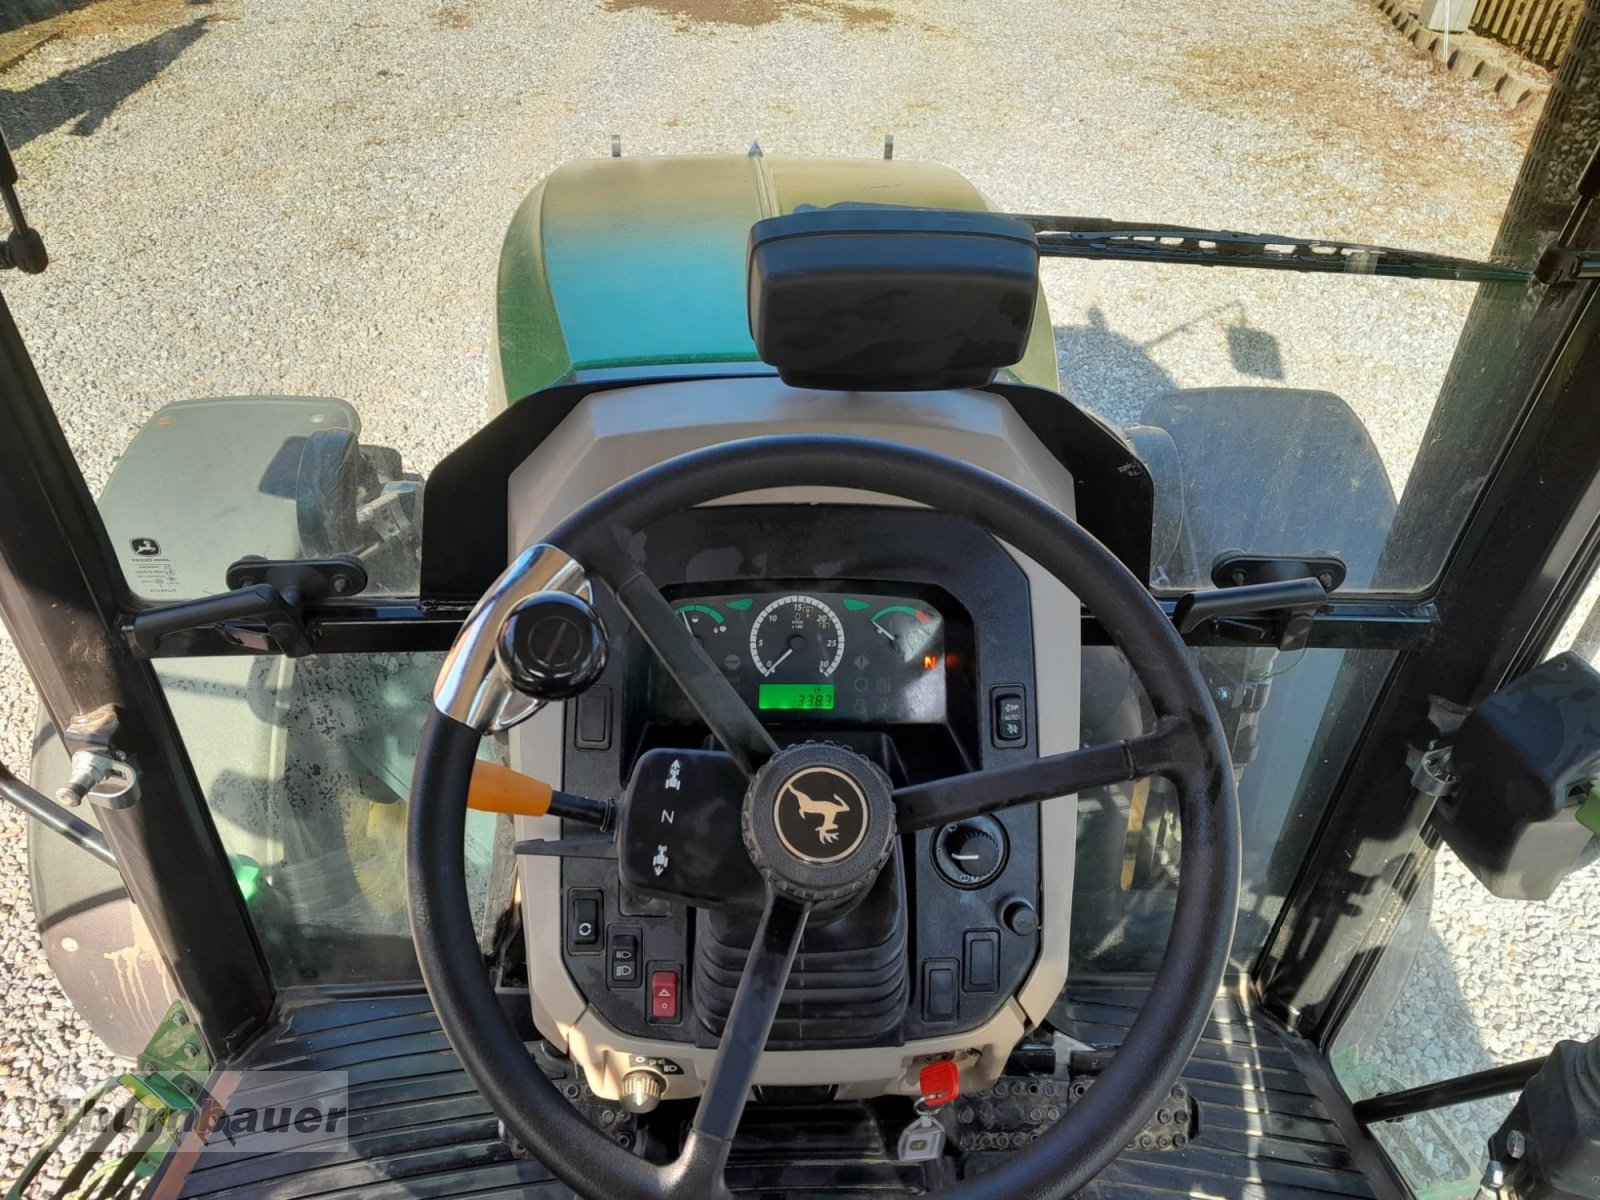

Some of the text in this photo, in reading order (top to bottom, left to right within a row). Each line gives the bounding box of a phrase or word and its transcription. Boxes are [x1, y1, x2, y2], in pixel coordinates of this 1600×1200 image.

[793, 603, 802, 611] 15
[768, 614, 777, 622] 10
[816, 614, 827, 622] 20
[758, 639, 763, 647] 5
[826, 639, 837, 647] 25
[924, 656, 937, 669] N
[799, 694, 832, 707] 3383
[661, 809, 674, 824] N
